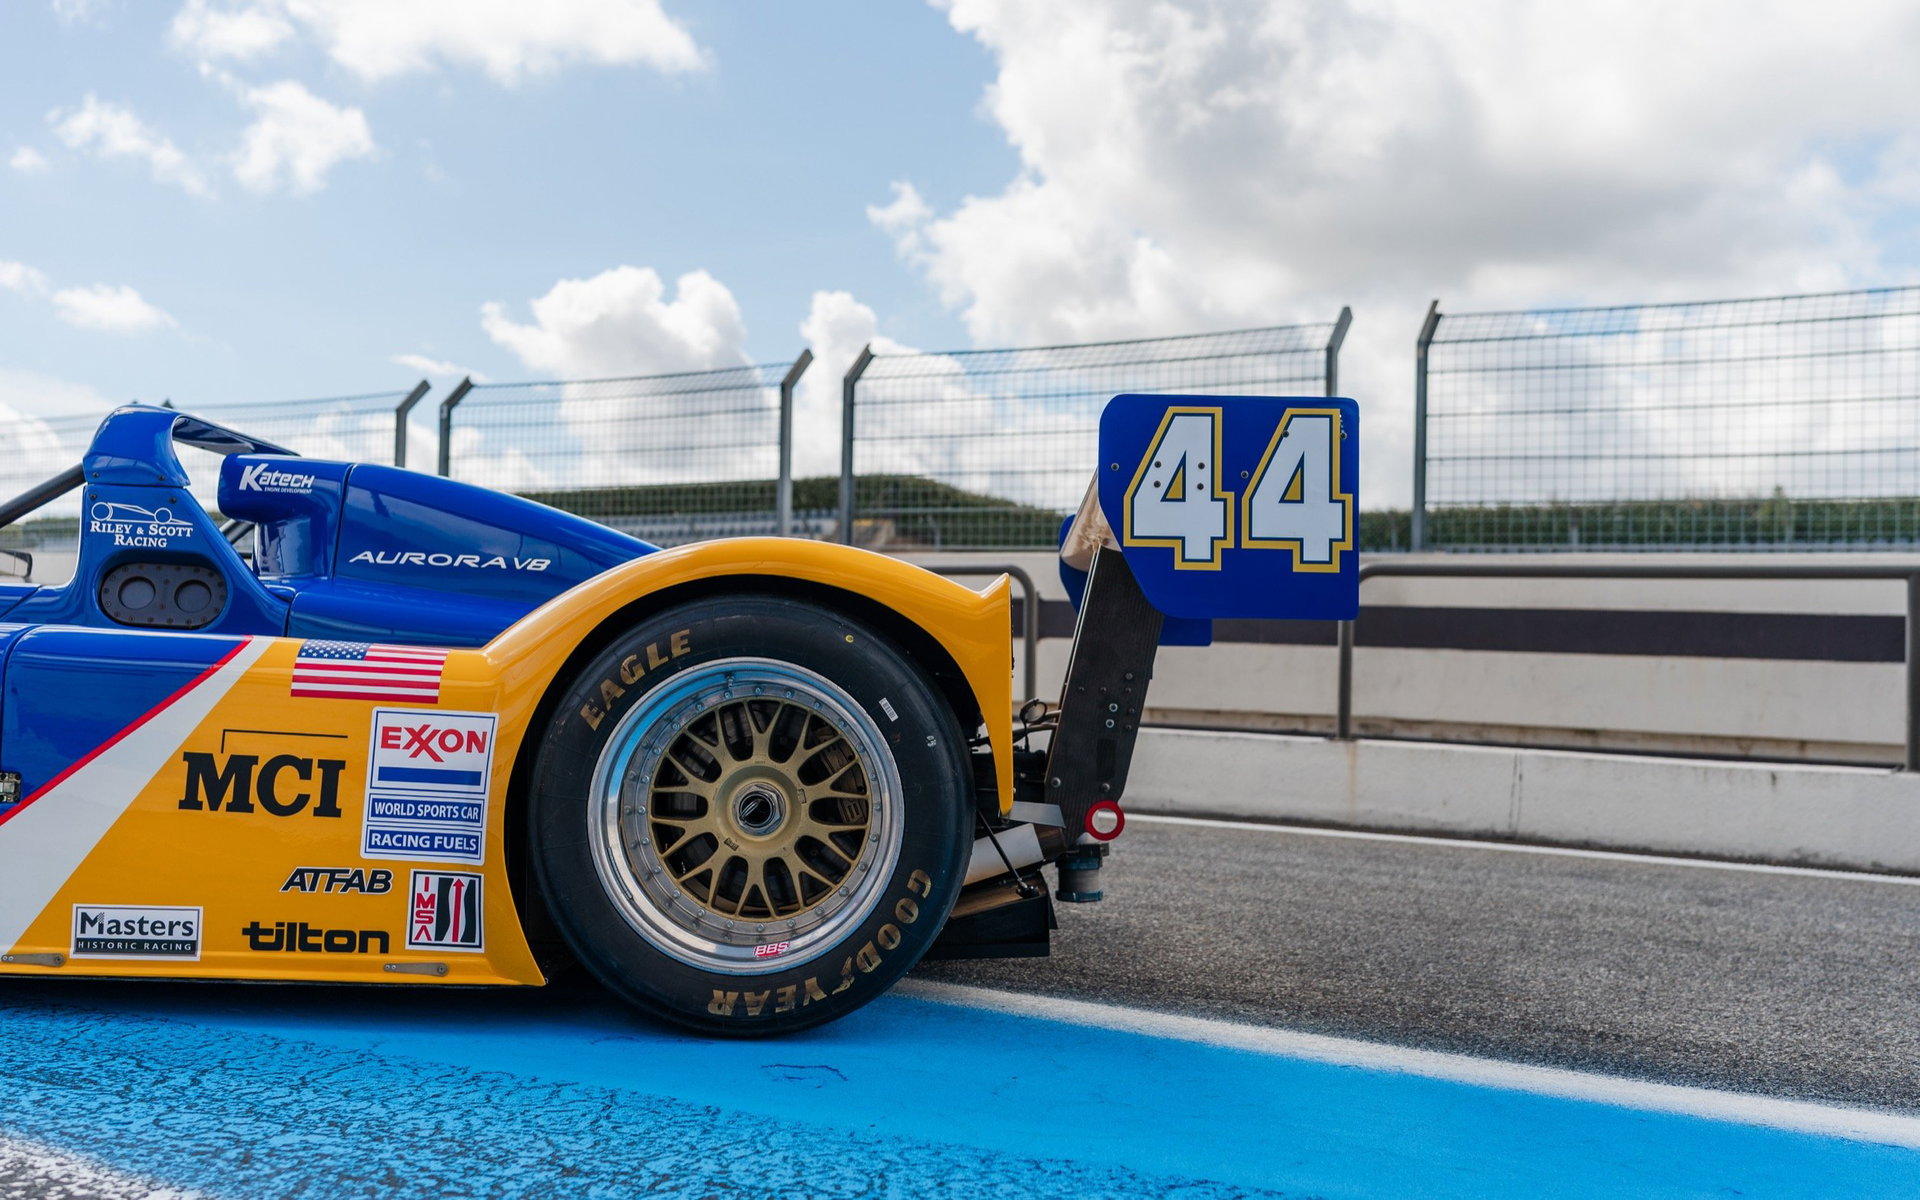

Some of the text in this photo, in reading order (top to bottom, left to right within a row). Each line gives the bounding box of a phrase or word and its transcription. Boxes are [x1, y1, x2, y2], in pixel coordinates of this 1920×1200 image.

[1123, 407, 1353, 573] 44
[136, 526, 144, 535] &
[349, 551, 551, 571] AURORA V8
[580, 629, 690, 731] EAGLE
[380, 724, 487, 762] EXXON
[178, 751, 346, 818] MCI
[374, 802, 479, 820] WORLD SPORTS CAR
[371, 833, 477, 851] RACING FUELS
[280, 867, 393, 894] ATFAB
[80, 911, 194, 936] Masters
[78, 941, 192, 951] HISTORIC RACING
[242, 921, 390, 954] tilton
[707, 868, 932, 1016] GOODYEAR
[754, 941, 788, 955] BBS
